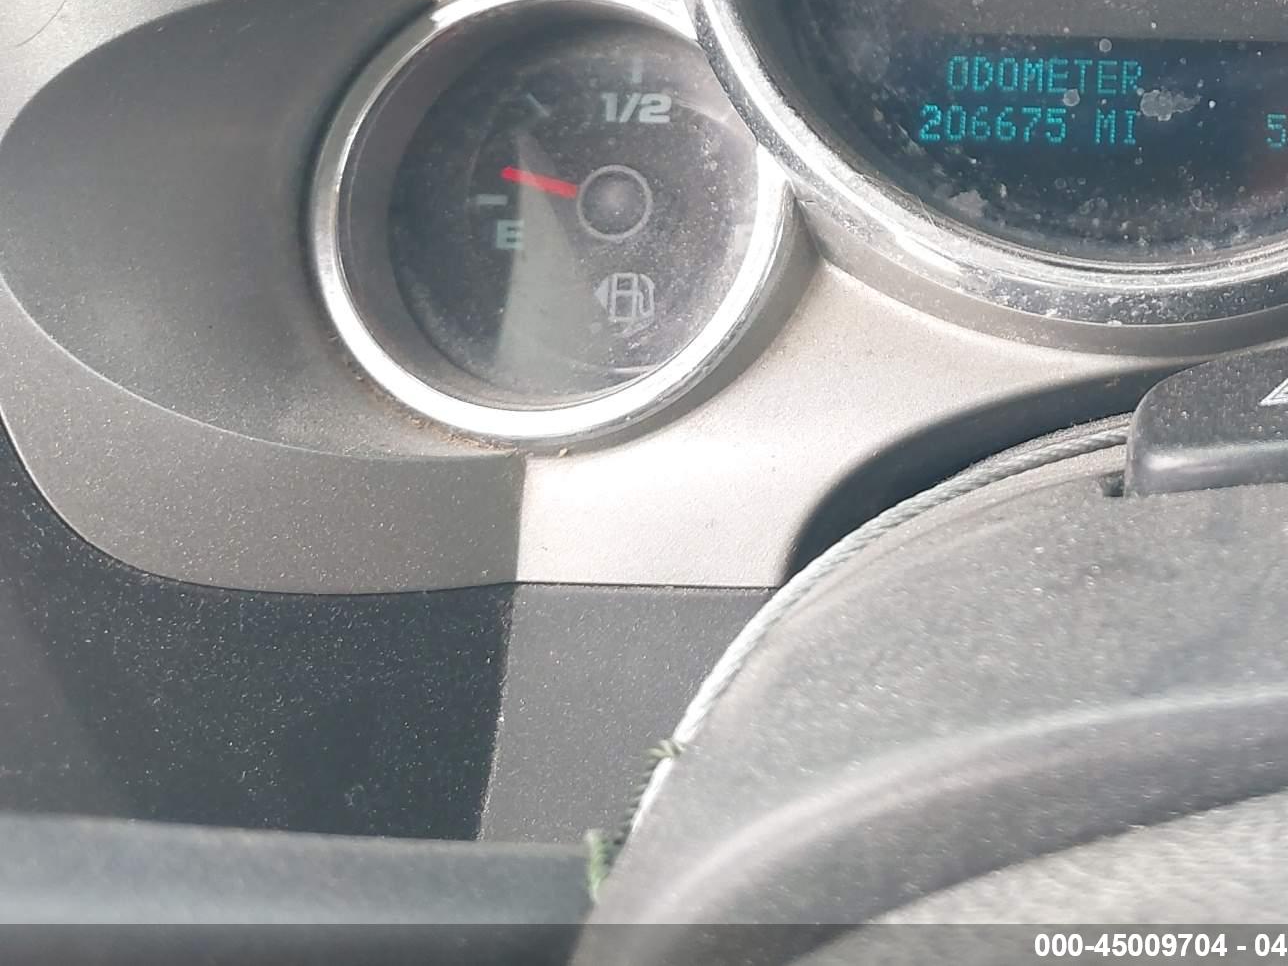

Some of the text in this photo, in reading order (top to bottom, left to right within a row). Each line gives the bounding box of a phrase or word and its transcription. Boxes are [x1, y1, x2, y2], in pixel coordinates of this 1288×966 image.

[946, 55, 1143, 94] ODOMETER
[603, 92, 671, 124] 1/2
[919, 104, 1137, 145] 206675 MI
